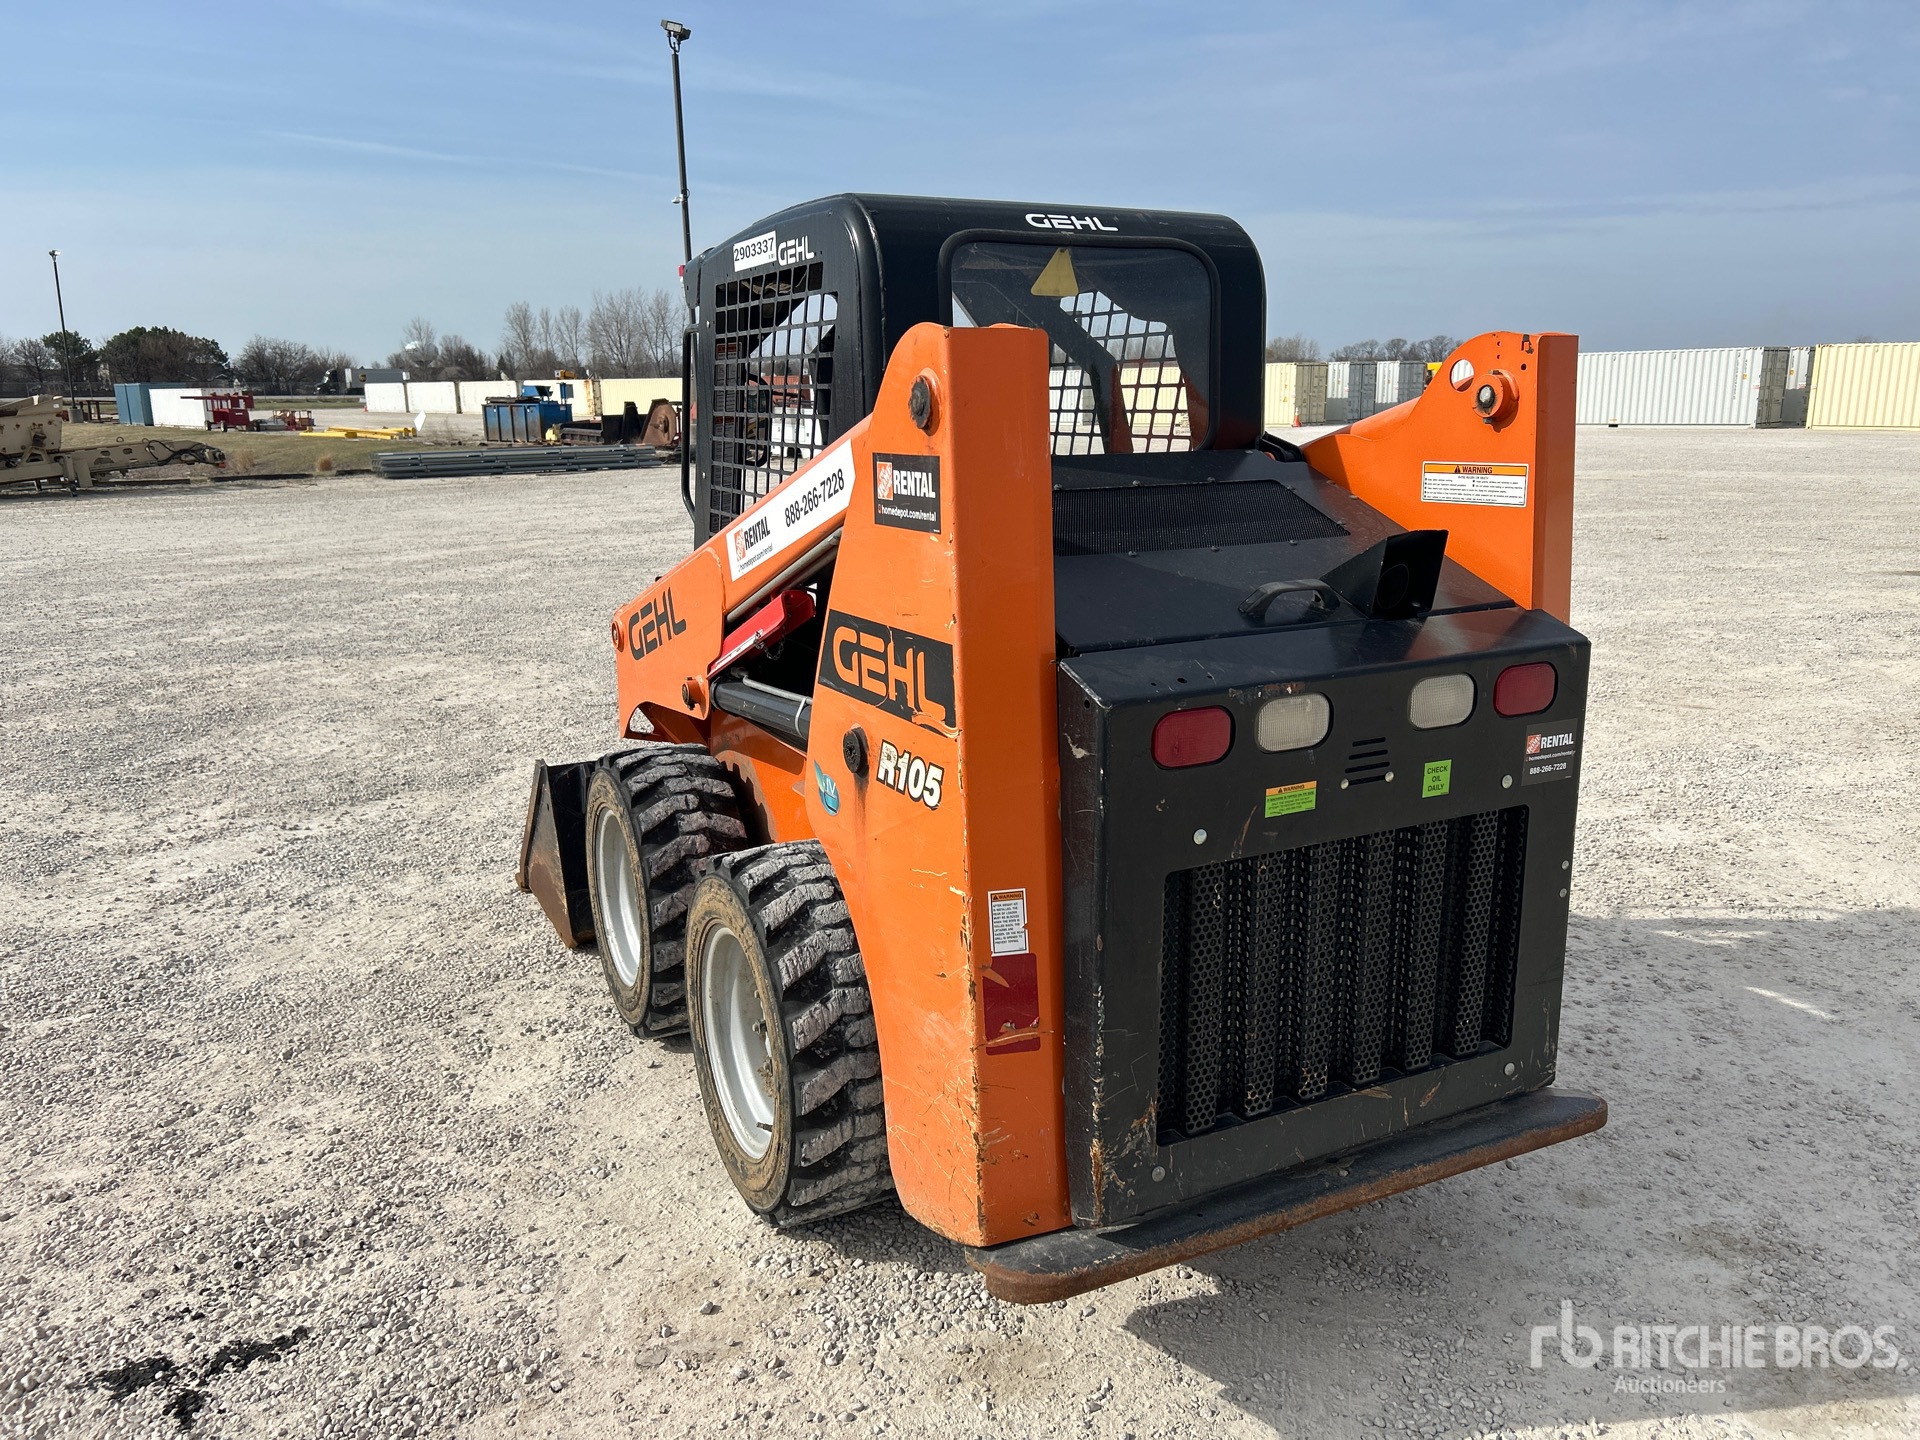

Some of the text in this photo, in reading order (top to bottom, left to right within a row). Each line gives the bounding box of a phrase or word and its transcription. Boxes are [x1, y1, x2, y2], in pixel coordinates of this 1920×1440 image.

[1025, 213, 1118, 231] GEHL
[733, 237, 774, 261] 2903337
[778, 235, 814, 266] GEHL
[1462, 466, 1492, 474] WARNING
[893, 470, 936, 498] RENTAL
[784, 469, 844, 528] 888-266-7228
[744, 516, 770, 550] RENTAL
[629, 586, 686, 660] GEHL
[832, 626, 945, 721] GEHL
[1540, 733, 1574, 749] RENTAL
[876, 739, 944, 810] R105
[1427, 765, 1448, 774] CHECK
[1530, 763, 1566, 775] 888-266-7228
[1284, 784, 1304, 792] WARNING
[1428, 784, 1444, 792] DAILY
